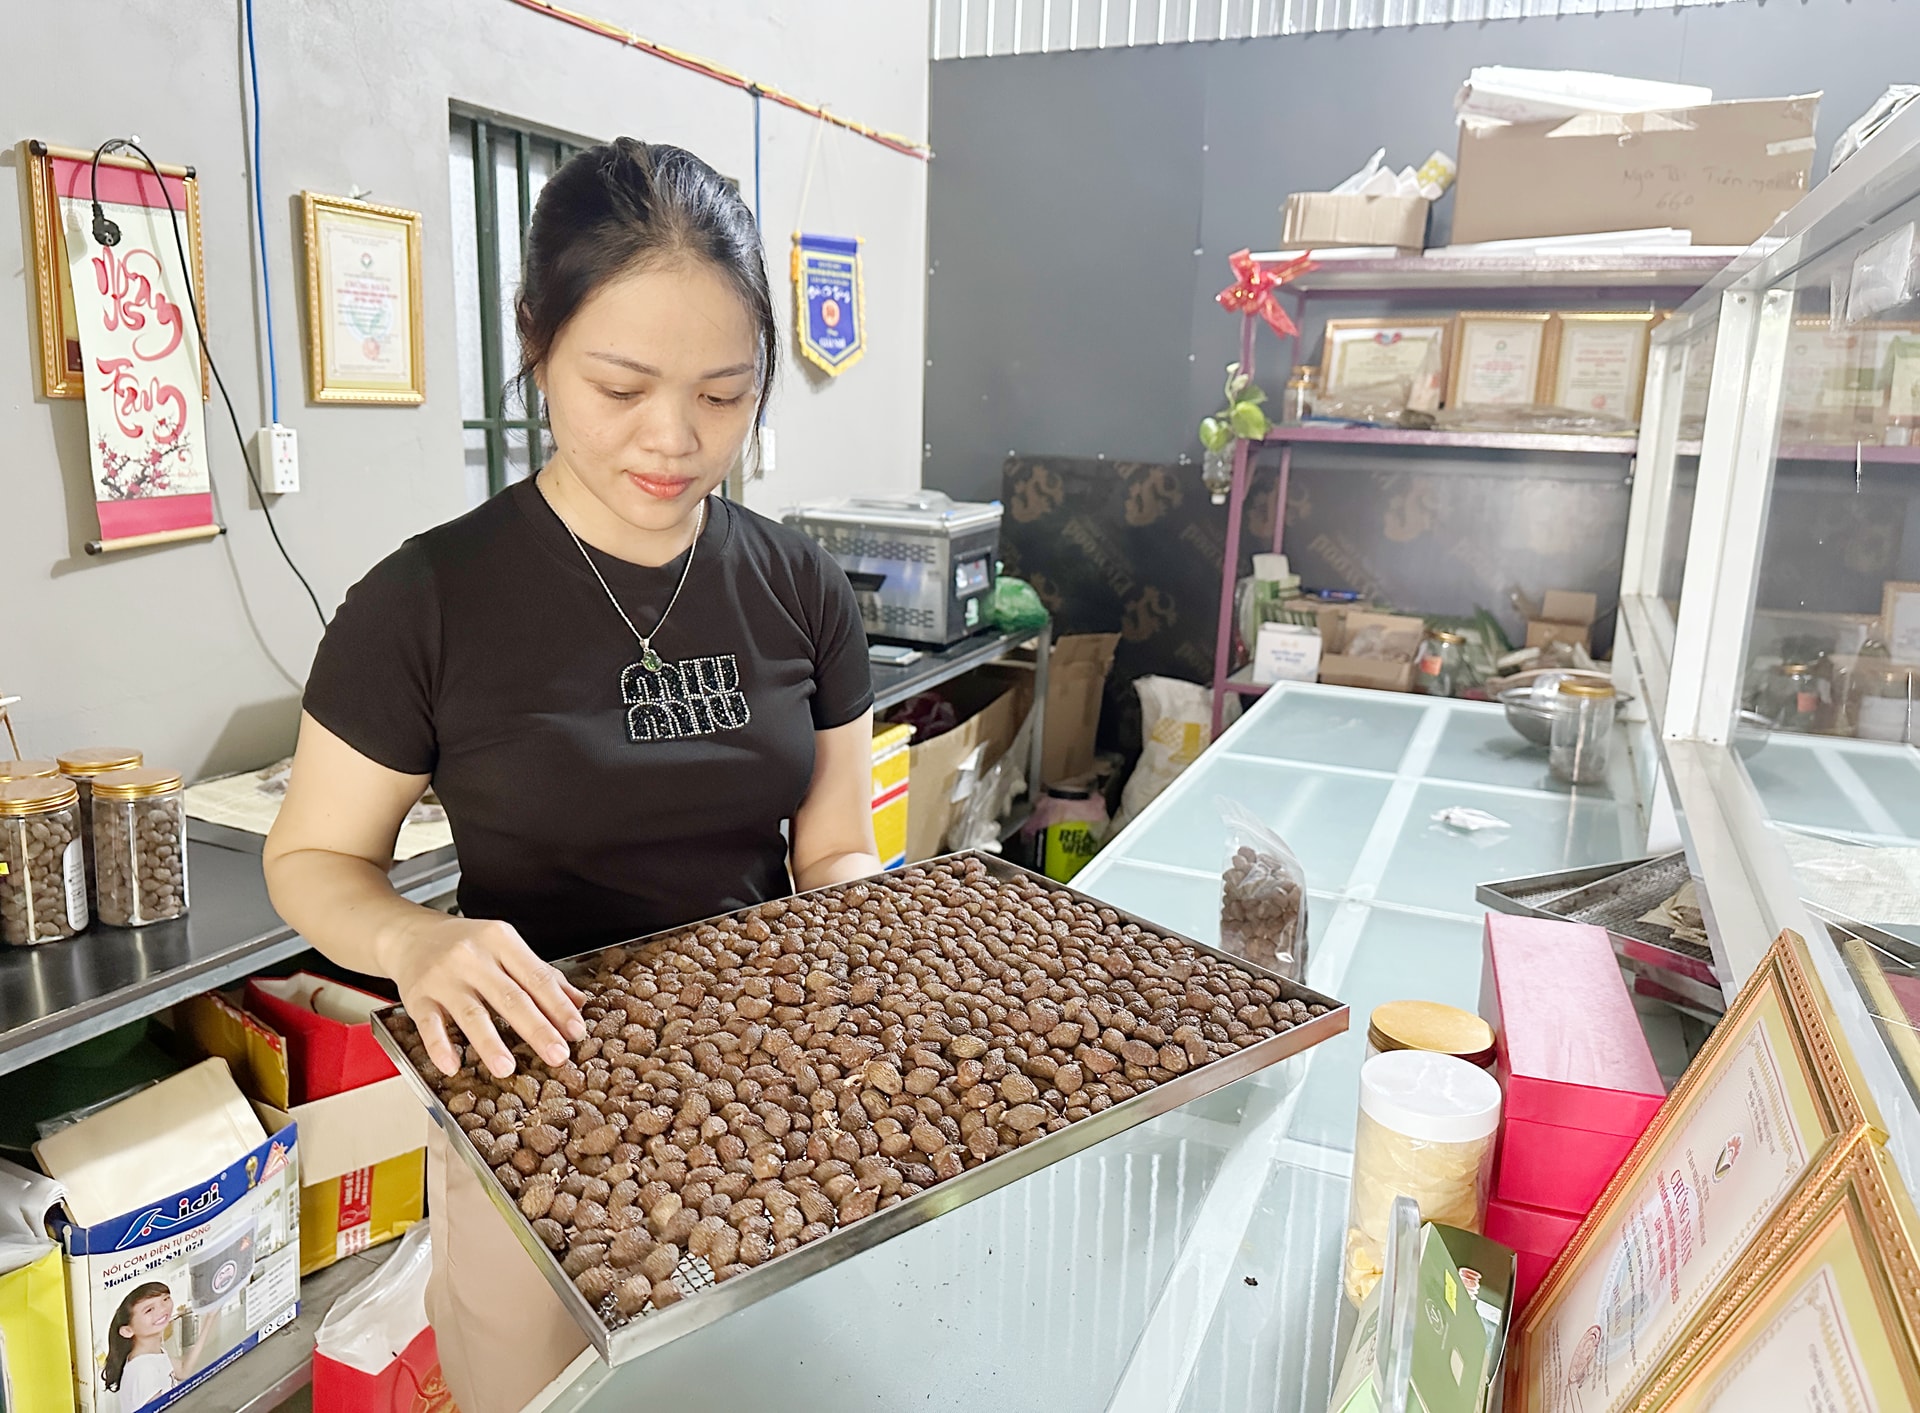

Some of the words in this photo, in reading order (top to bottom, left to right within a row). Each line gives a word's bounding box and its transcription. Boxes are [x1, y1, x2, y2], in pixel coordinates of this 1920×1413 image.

[1670, 1169, 1692, 1223] CHỨNG
[124, 1252, 148, 1269] CƠM
[150, 1243, 171, 1258] ĐIỆN
[184, 1225, 211, 1242] ĐỘNG
[104, 1269, 140, 1290] Model:
